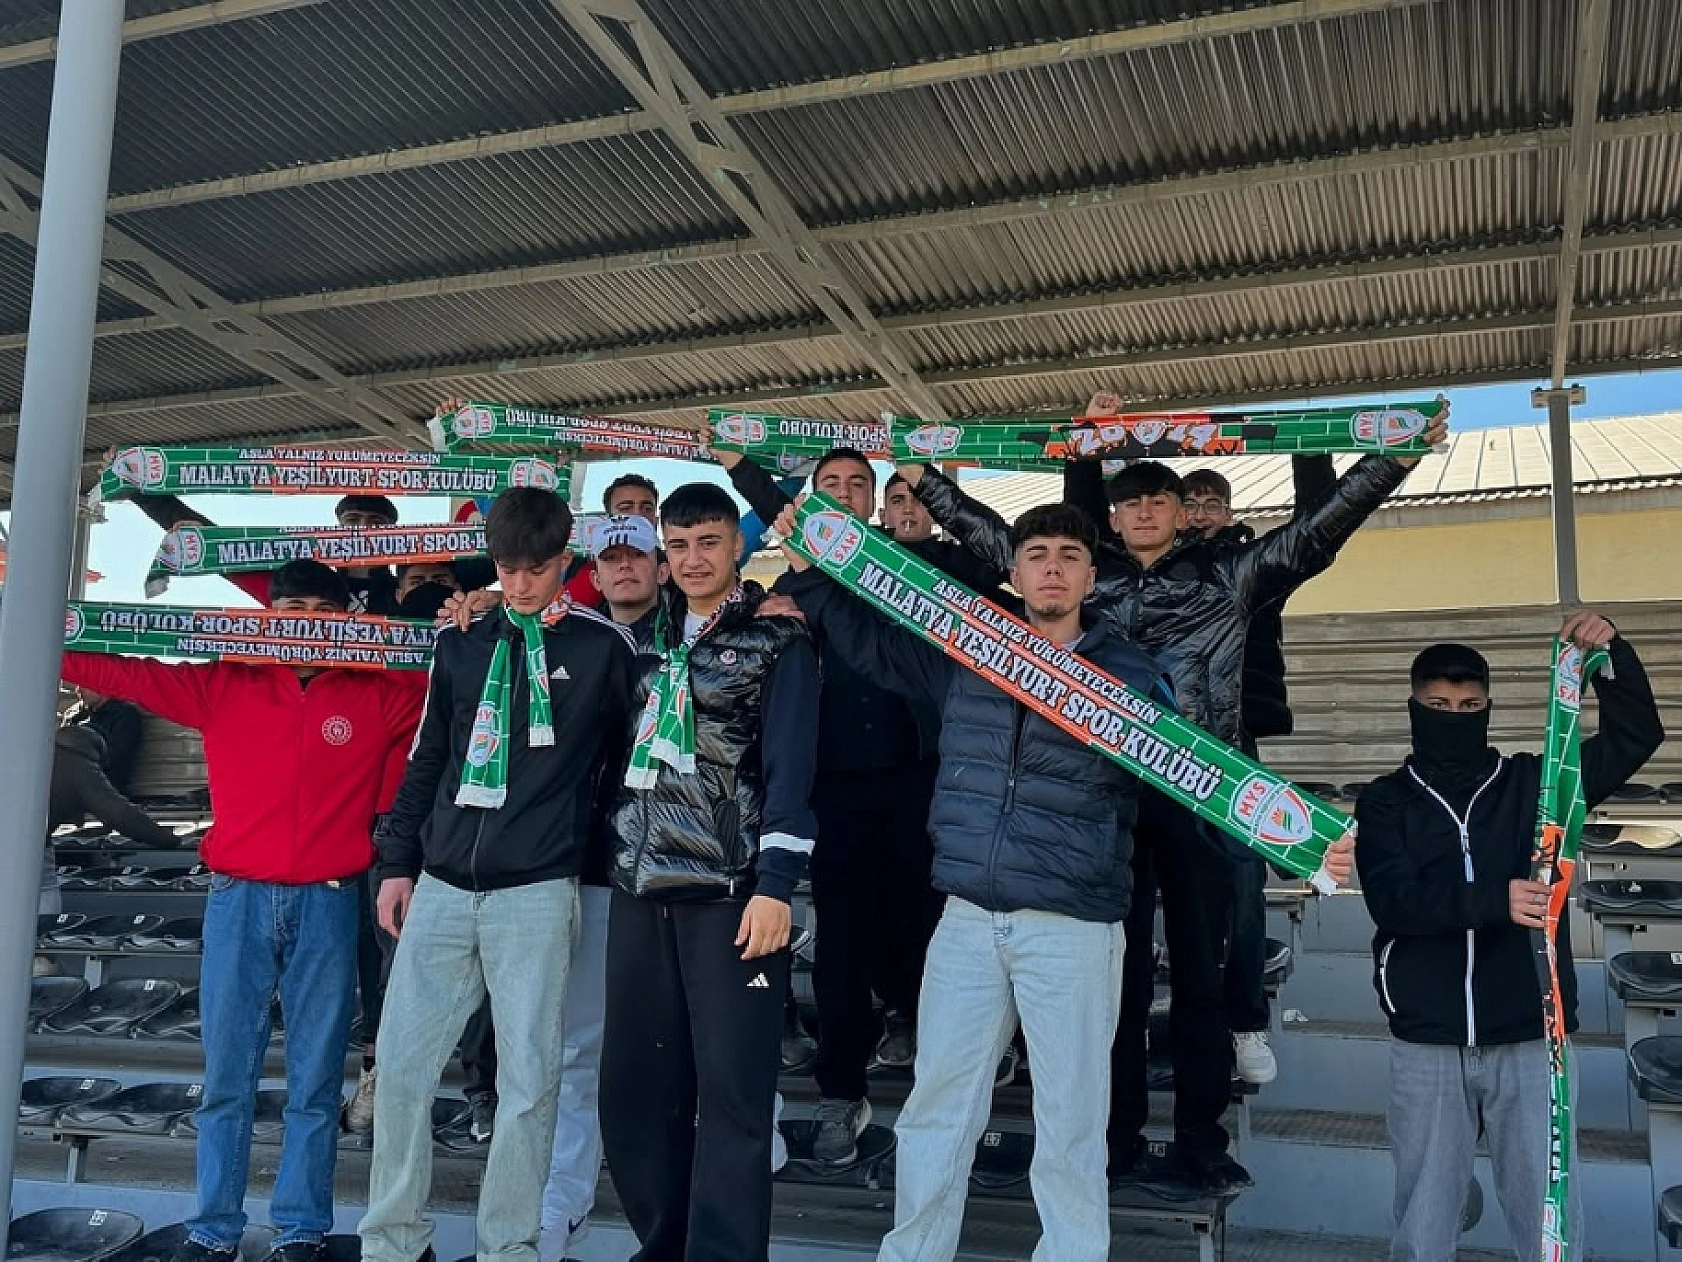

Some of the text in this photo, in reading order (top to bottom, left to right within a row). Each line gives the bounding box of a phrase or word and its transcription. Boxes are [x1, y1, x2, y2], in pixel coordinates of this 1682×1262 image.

[179, 461, 498, 491] MALATYA YEŞİLYURT SPOR KULÜBÜ
[218, 540, 313, 563] MALATYA
[317, 530, 419, 562] YEŞİLYURT
[423, 533, 471, 552] SPOR
[101, 610, 194, 634] KULÜBÜ
[201, 615, 261, 636] SPOR
[265, 617, 385, 647] YEŞİLYURT
[932, 578, 1162, 724] ASLA YALNIZ YÜRÜMEYECEKSİN
[857, 561, 1223, 801] MALATYA YEŞİLYURT SPOR KULÜBÜ
